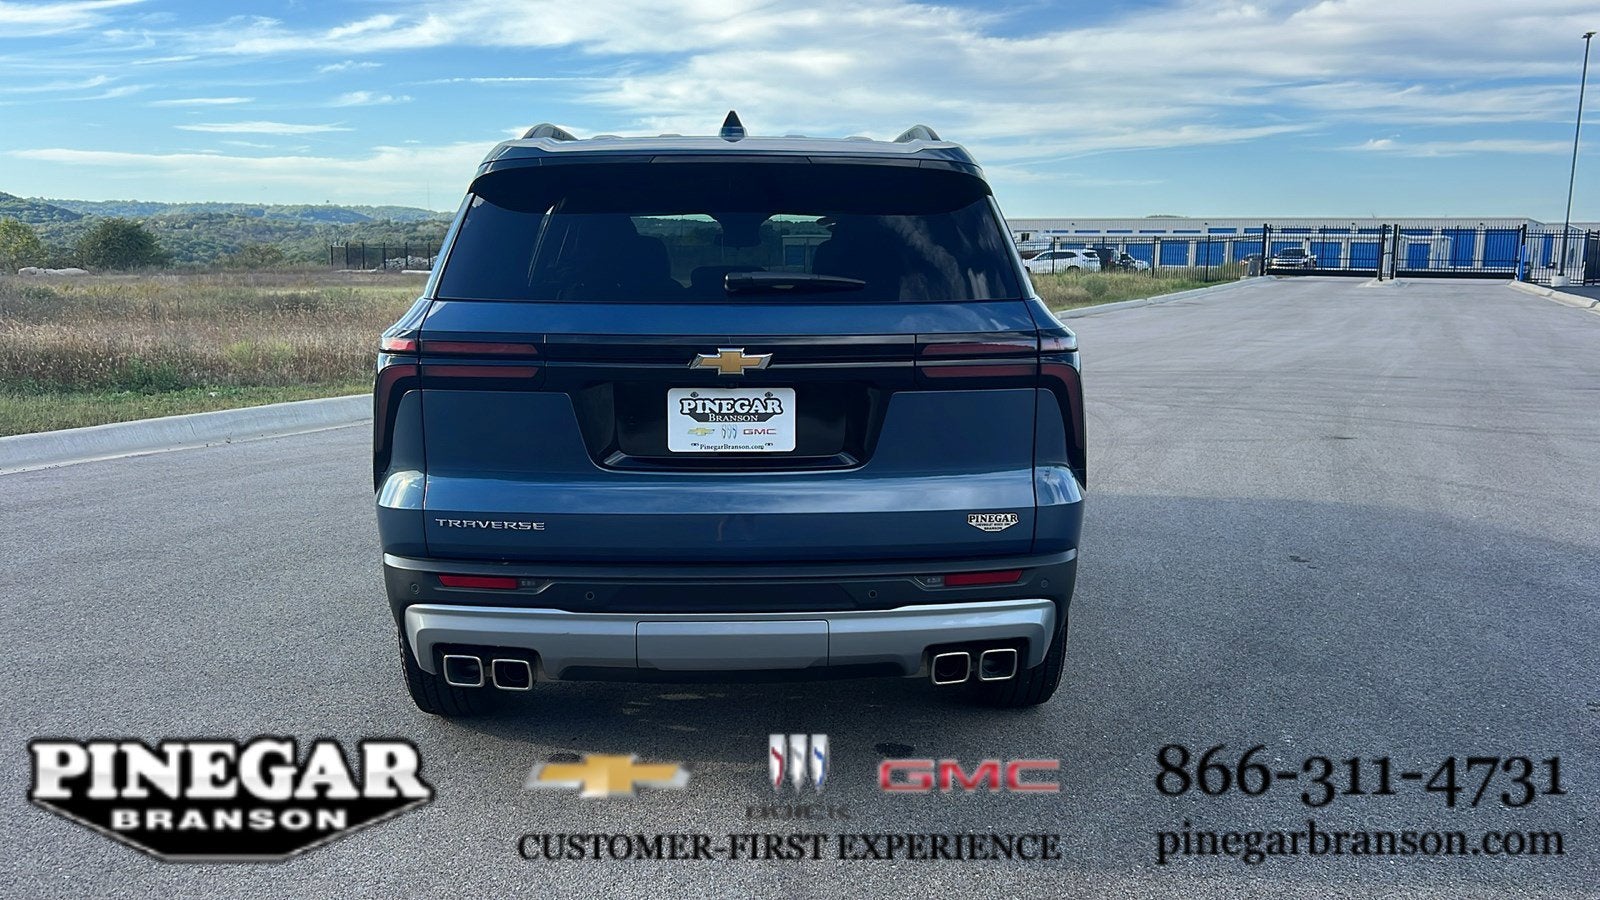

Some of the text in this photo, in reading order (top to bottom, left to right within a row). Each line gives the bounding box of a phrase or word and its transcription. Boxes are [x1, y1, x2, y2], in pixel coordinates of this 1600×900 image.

[680, 398, 783, 414] PINEGAR
[435, 518, 545, 531] TRAVERSE
[968, 514, 1017, 523] PINEGAR
